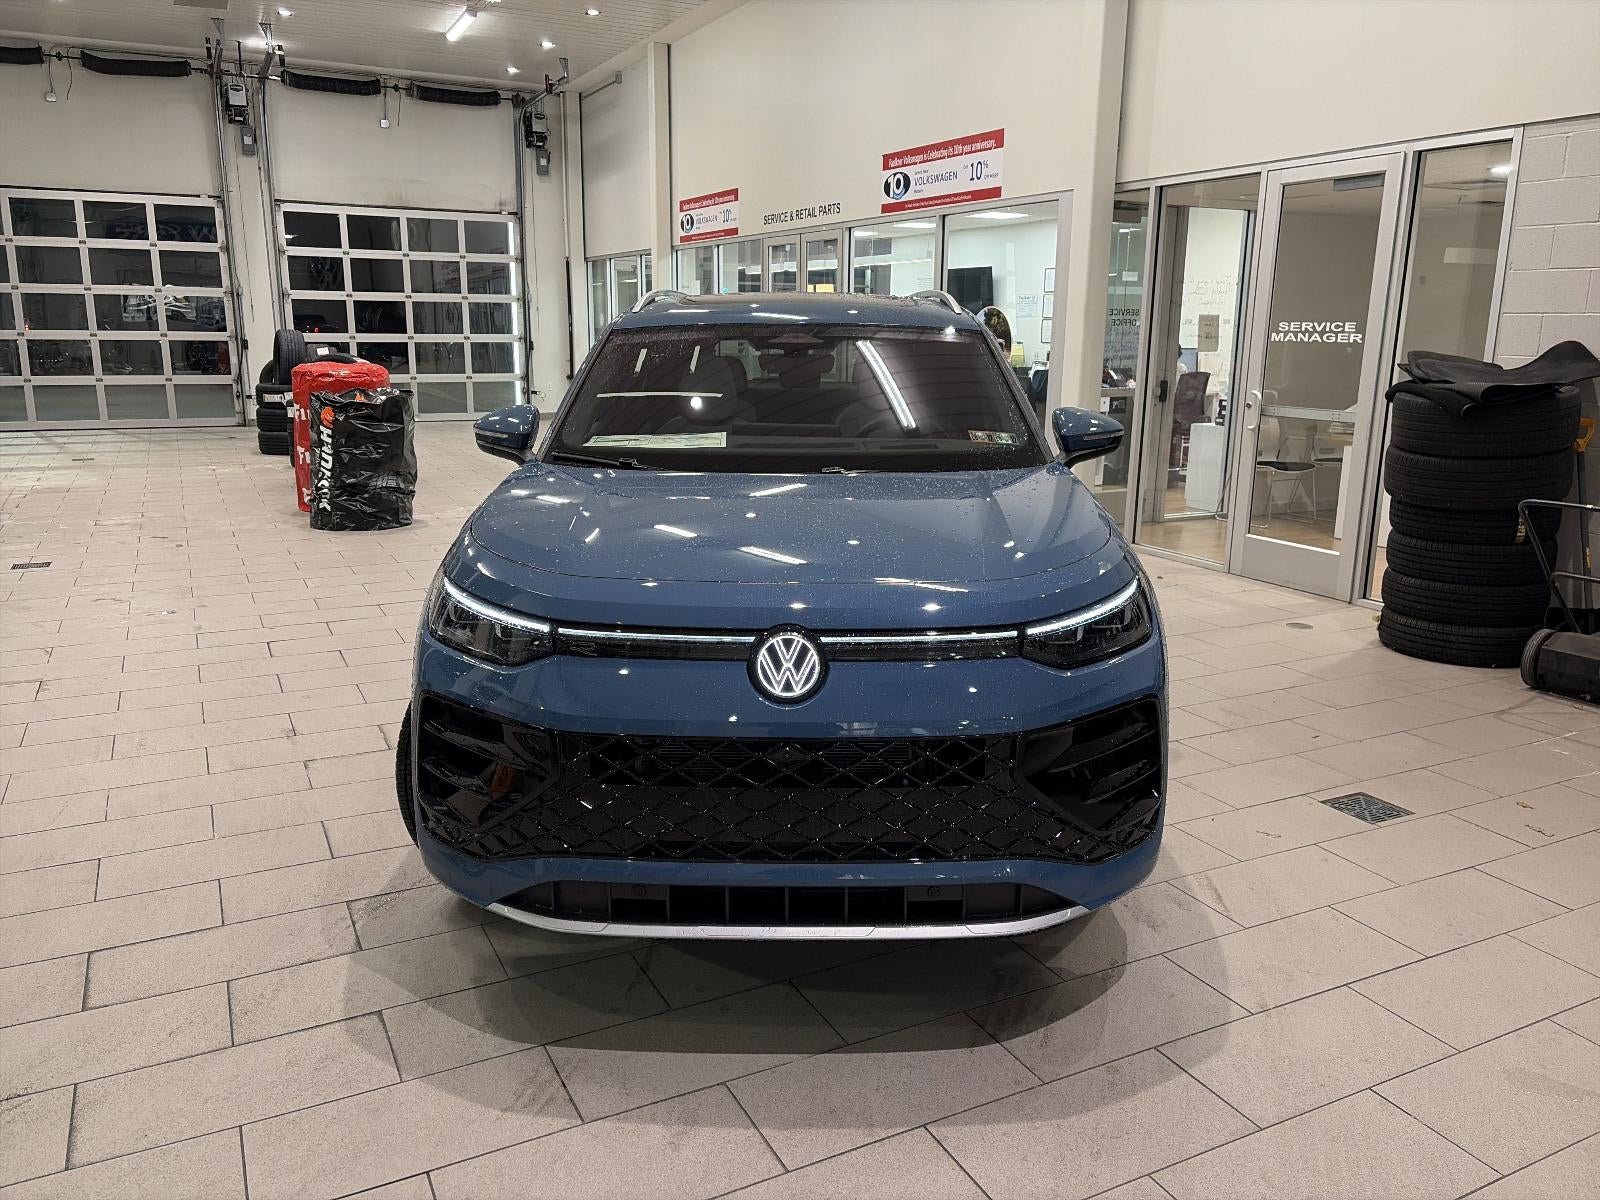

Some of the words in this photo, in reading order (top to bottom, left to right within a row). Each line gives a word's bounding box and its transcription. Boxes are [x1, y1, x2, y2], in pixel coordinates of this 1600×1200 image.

[914, 171, 958, 186] VOLKSWAGEN
[763, 211, 788, 225] SERVICE
[789, 211, 794, 221] &
[795, 207, 817, 220] RETAIL
[819, 202, 841, 216] PARTS
[1278, 321, 1357, 332] SERVICE
[1271, 332, 1363, 343] MANAGER
[758, 636, 819, 696] VW
